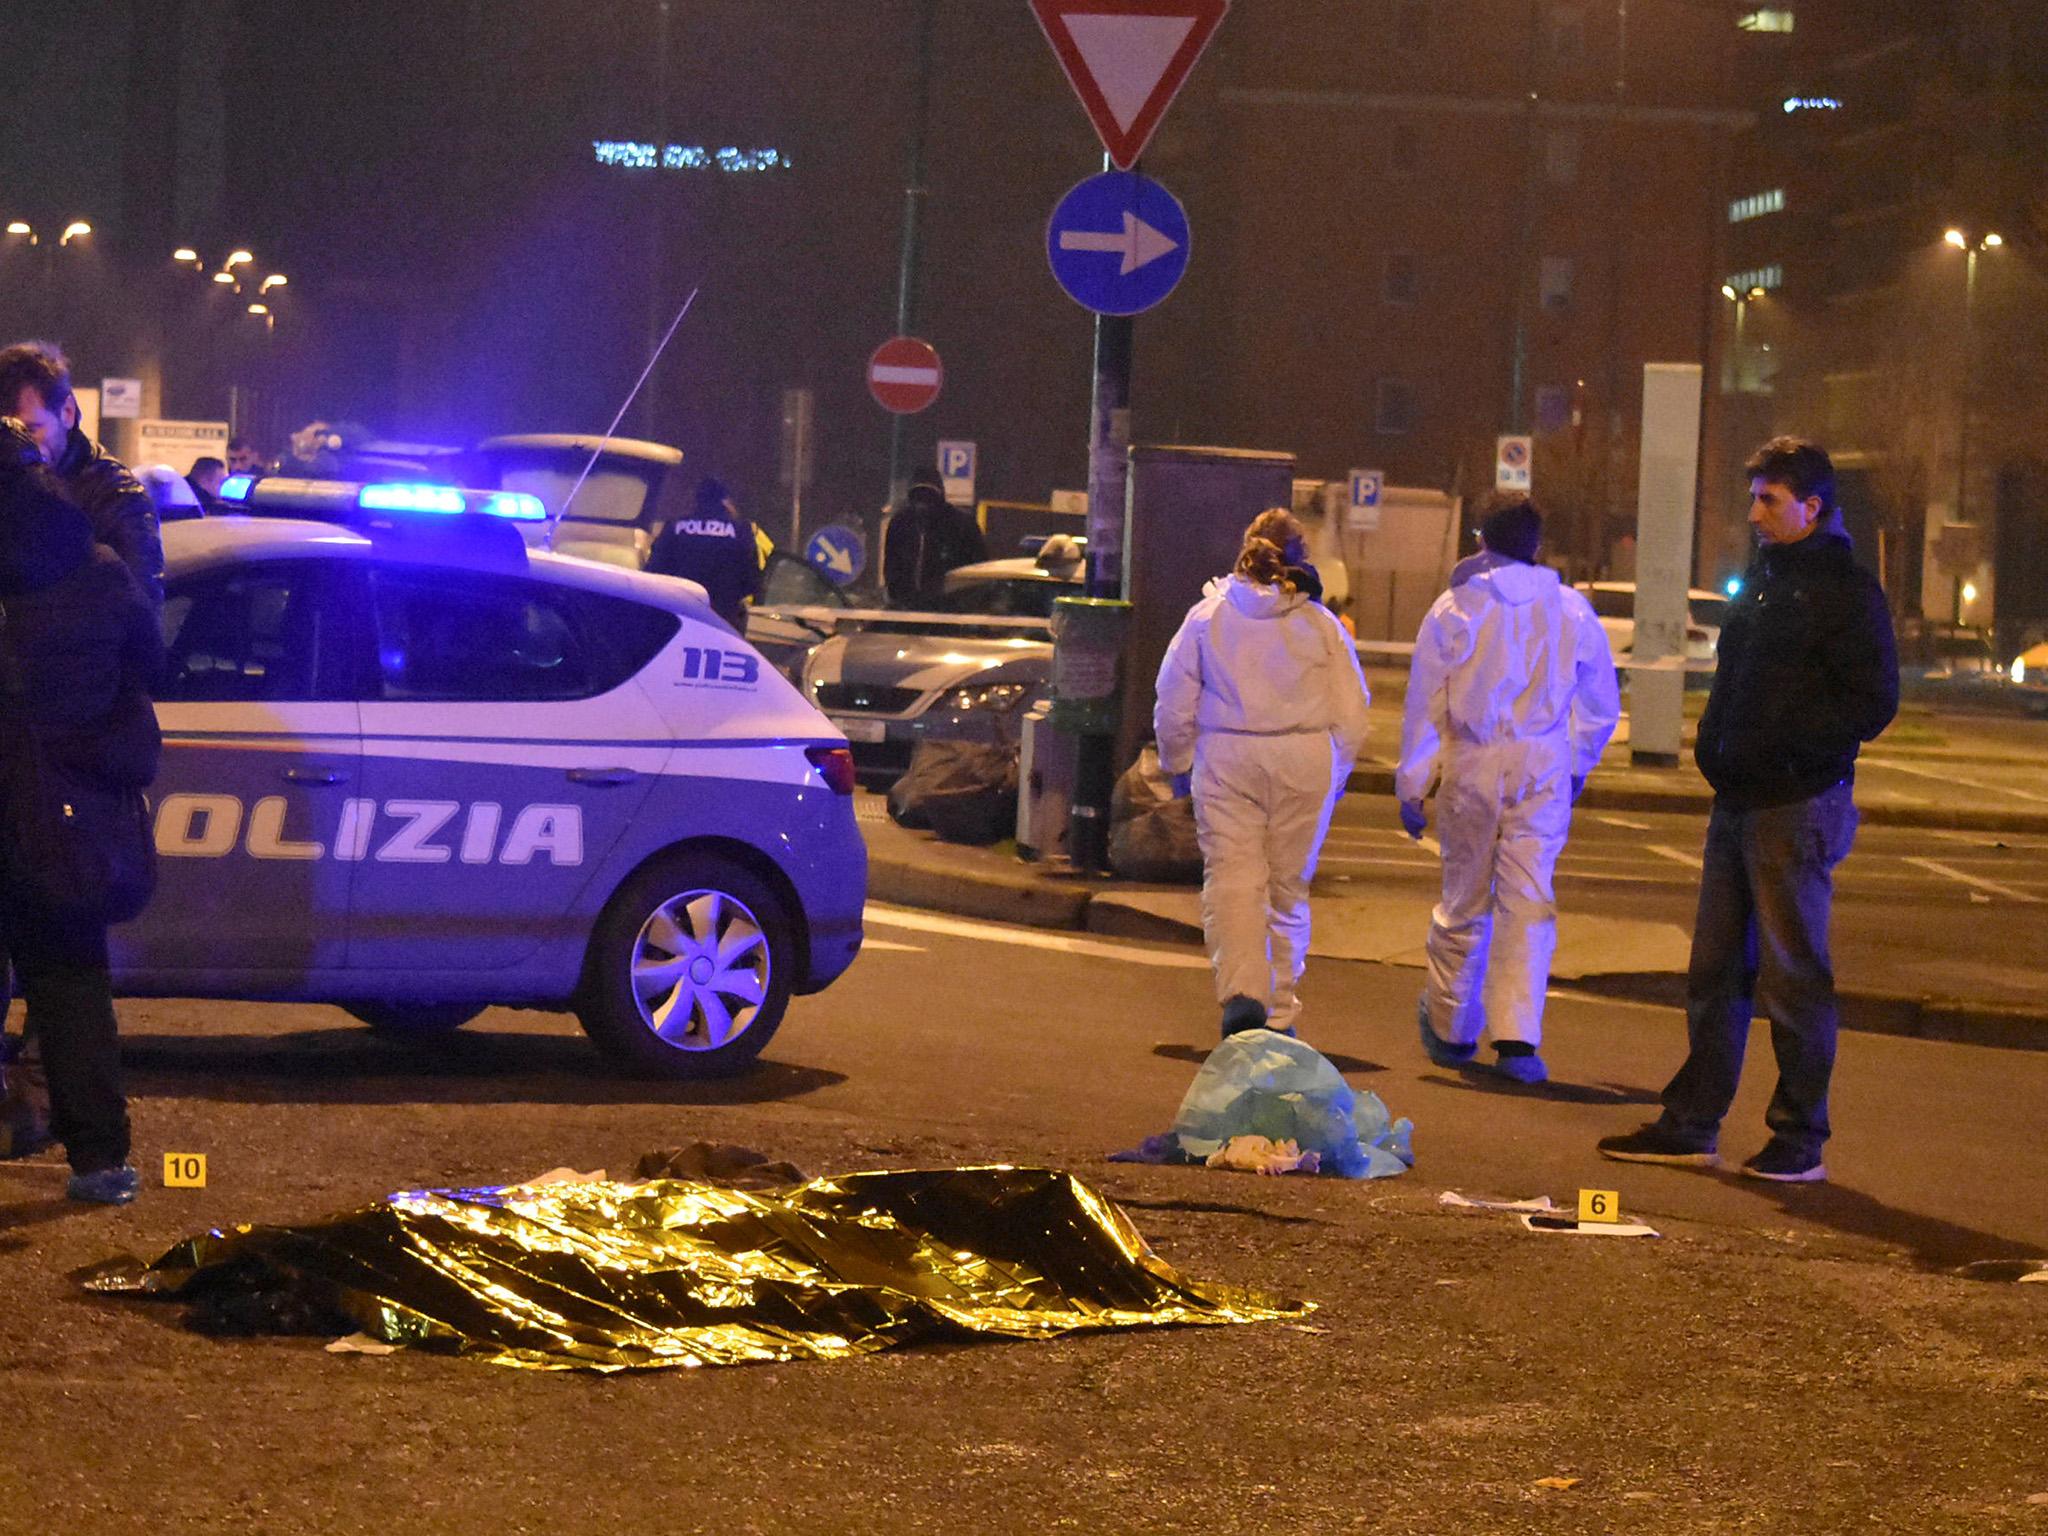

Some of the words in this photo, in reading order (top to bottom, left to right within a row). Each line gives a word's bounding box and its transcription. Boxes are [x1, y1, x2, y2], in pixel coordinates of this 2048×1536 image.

[949, 450, 967, 477] P
[1358, 478, 1376, 505] P
[675, 520, 736, 538] POLIZIA
[683, 647, 759, 683] 113
[142, 793, 584, 866] OLIZIA
[169, 1157, 200, 1180] 10
[1590, 1194, 1606, 1215] 6
